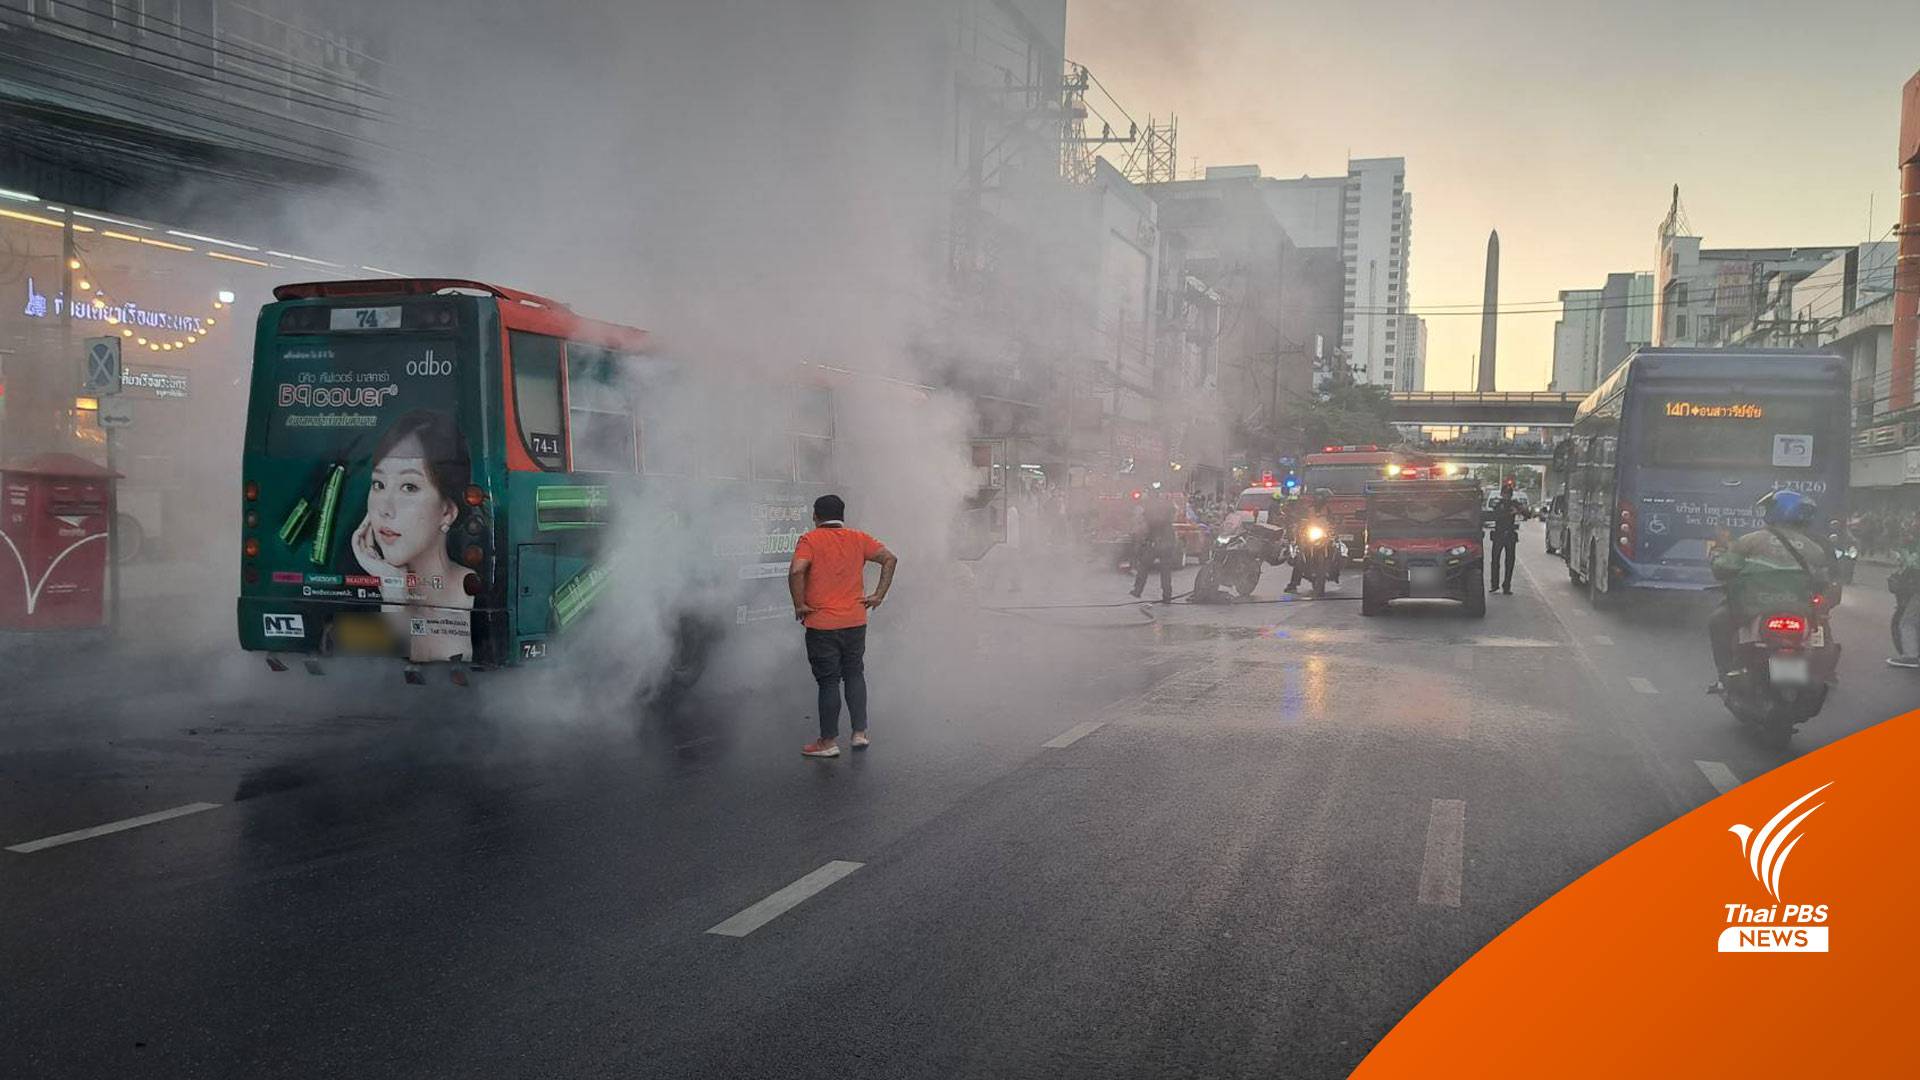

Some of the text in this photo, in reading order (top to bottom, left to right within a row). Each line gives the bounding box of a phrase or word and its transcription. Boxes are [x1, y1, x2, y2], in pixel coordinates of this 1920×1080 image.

[356, 310, 378, 328] 74
[406, 350, 453, 376] odbo
[532, 437, 559, 454] 74-1
[523, 643, 546, 658] 74-1
